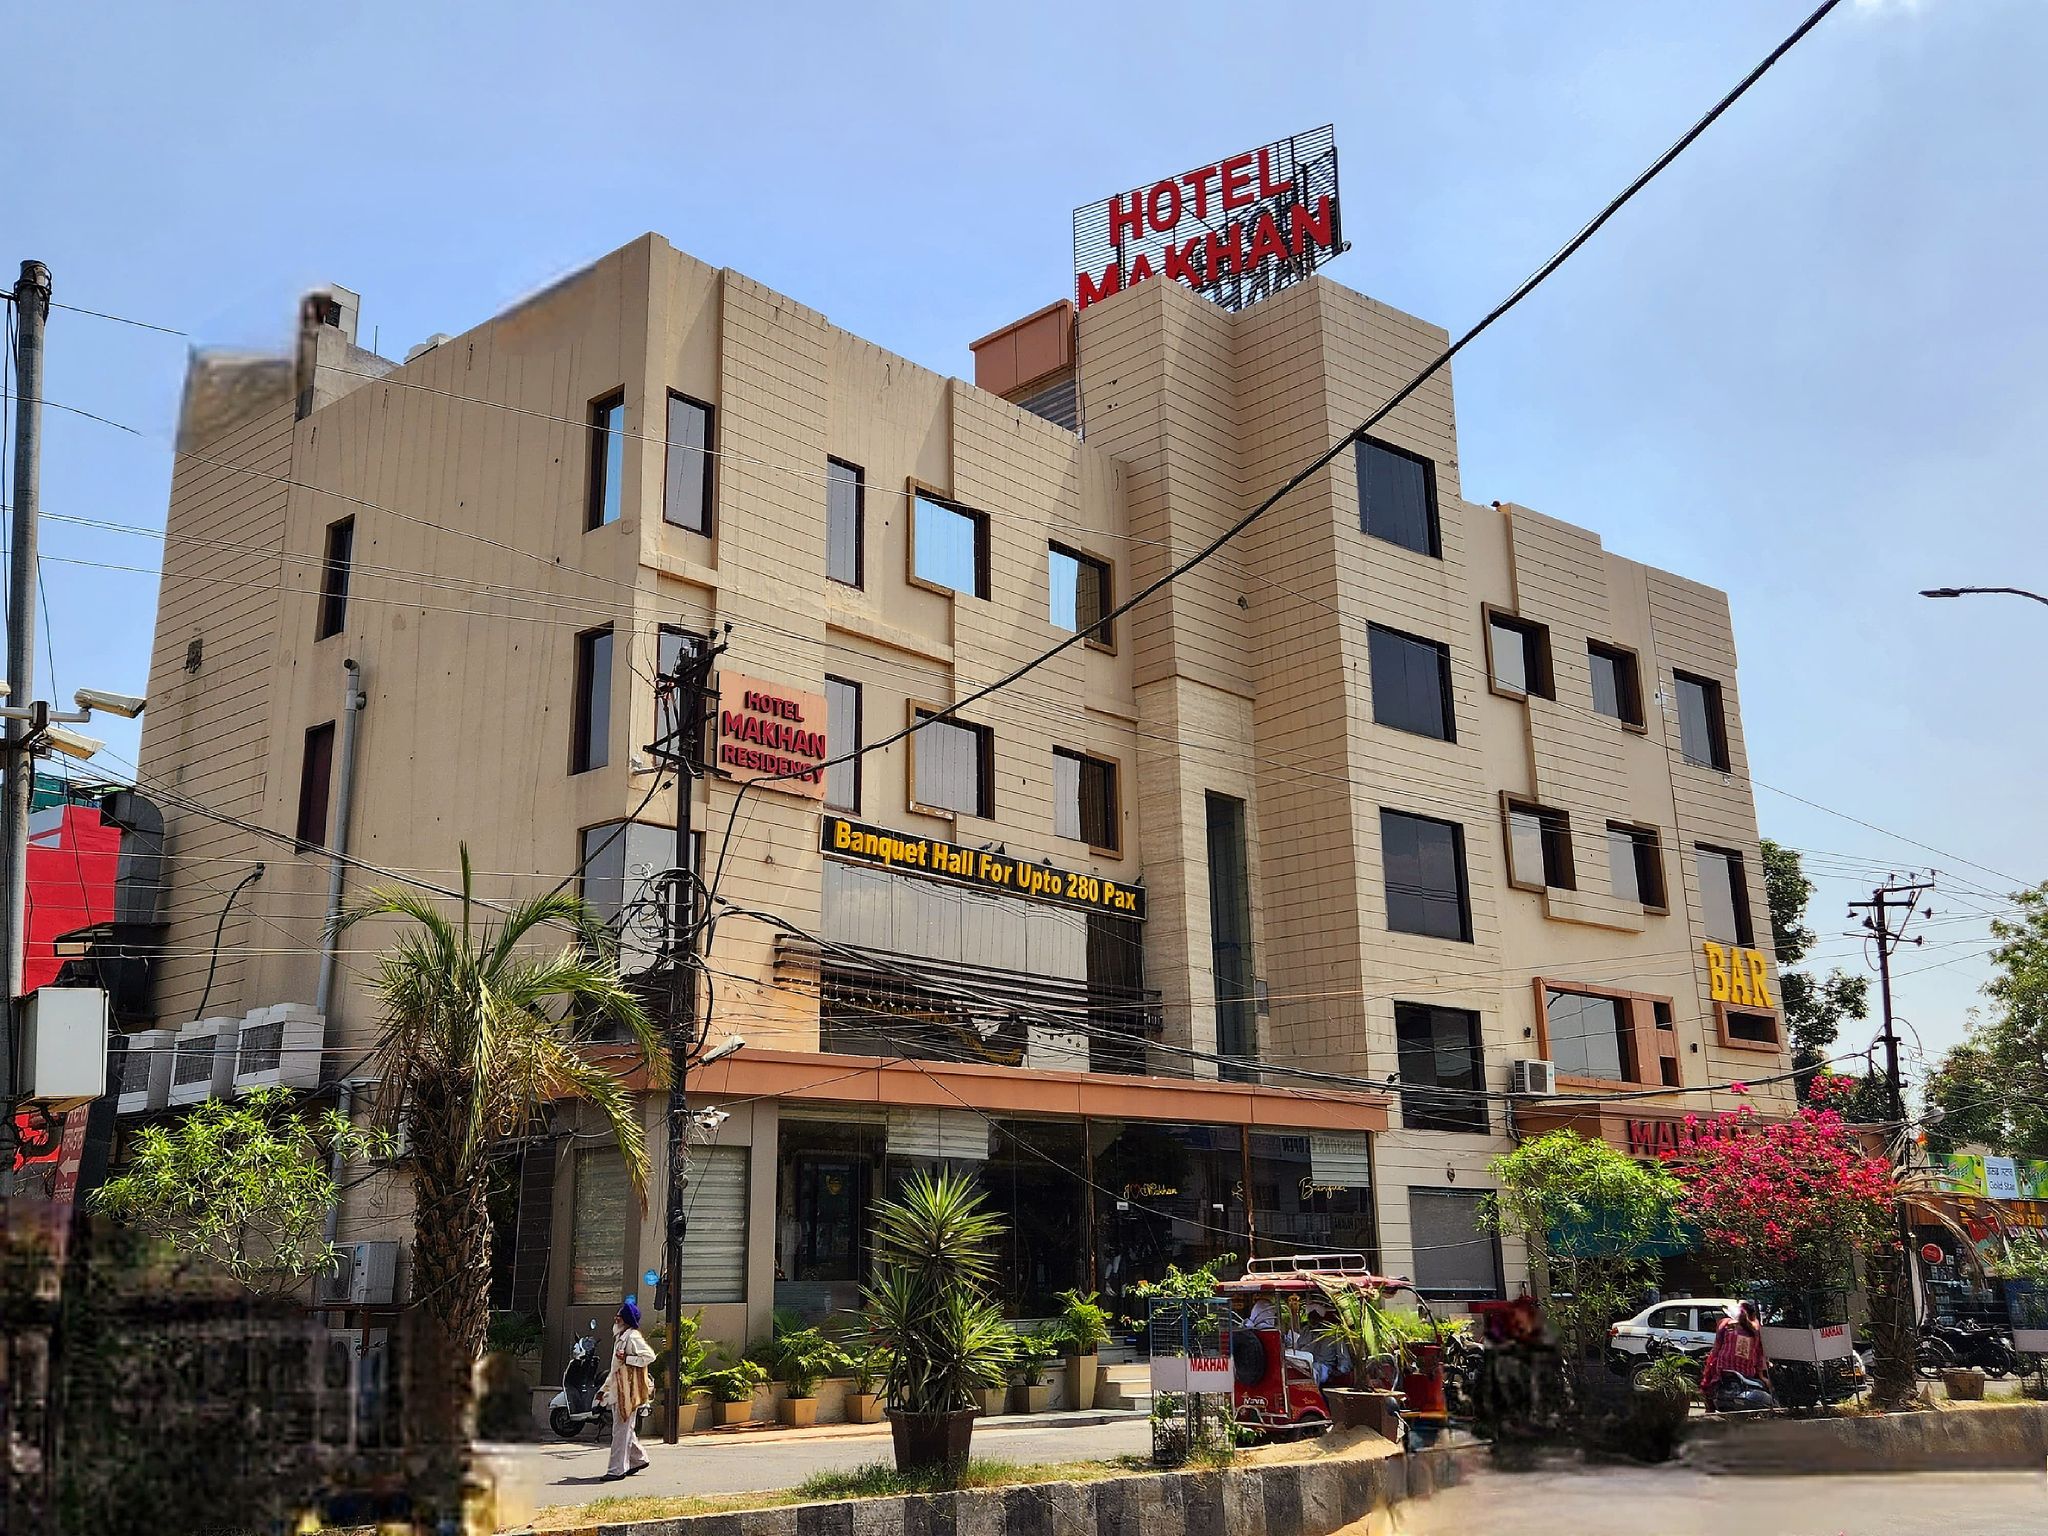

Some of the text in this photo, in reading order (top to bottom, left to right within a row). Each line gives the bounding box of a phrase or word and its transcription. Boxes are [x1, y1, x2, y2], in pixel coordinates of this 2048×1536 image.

[1108, 147, 1293, 248] HOTEL
[1077, 195, 1333, 311] MAKHAN
[722, 710, 826, 760] MAKHAN
[744, 690, 805, 722] HOTEL
[722, 744, 825, 784] RESIDENCY
[834, 818, 1136, 911] Banquet Hall For Upto 280 Pax
[1703, 941, 1775, 1008] BAR
[1190, 1356, 1229, 1372] MAKHAN
